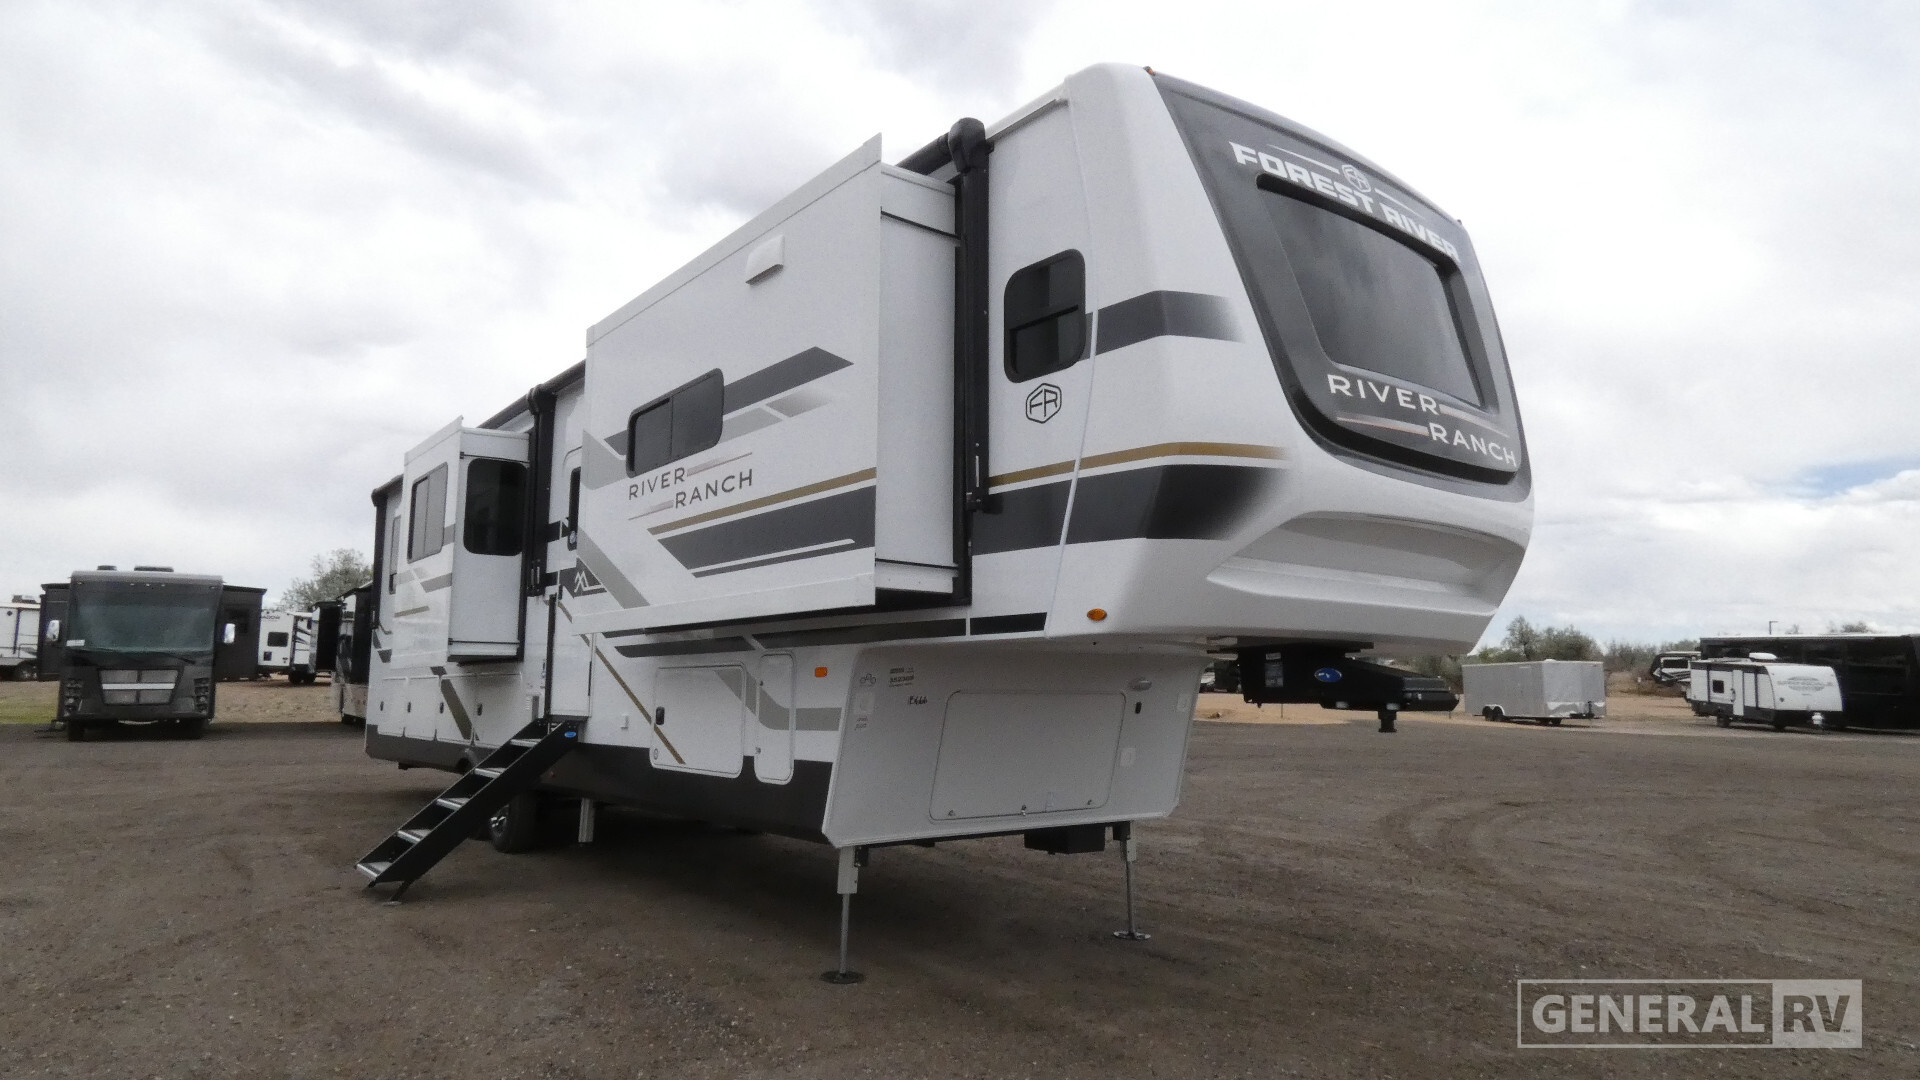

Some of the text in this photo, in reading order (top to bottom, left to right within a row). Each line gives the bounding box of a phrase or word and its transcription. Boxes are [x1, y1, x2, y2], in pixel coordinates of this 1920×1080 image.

[1229, 141, 1461, 263] FOREST RIVER
[1327, 374, 1440, 415] RIVER
[1429, 422, 1517, 467] RANCH
[628, 467, 686, 500] RIVER
[675, 468, 753, 509] RANCH
